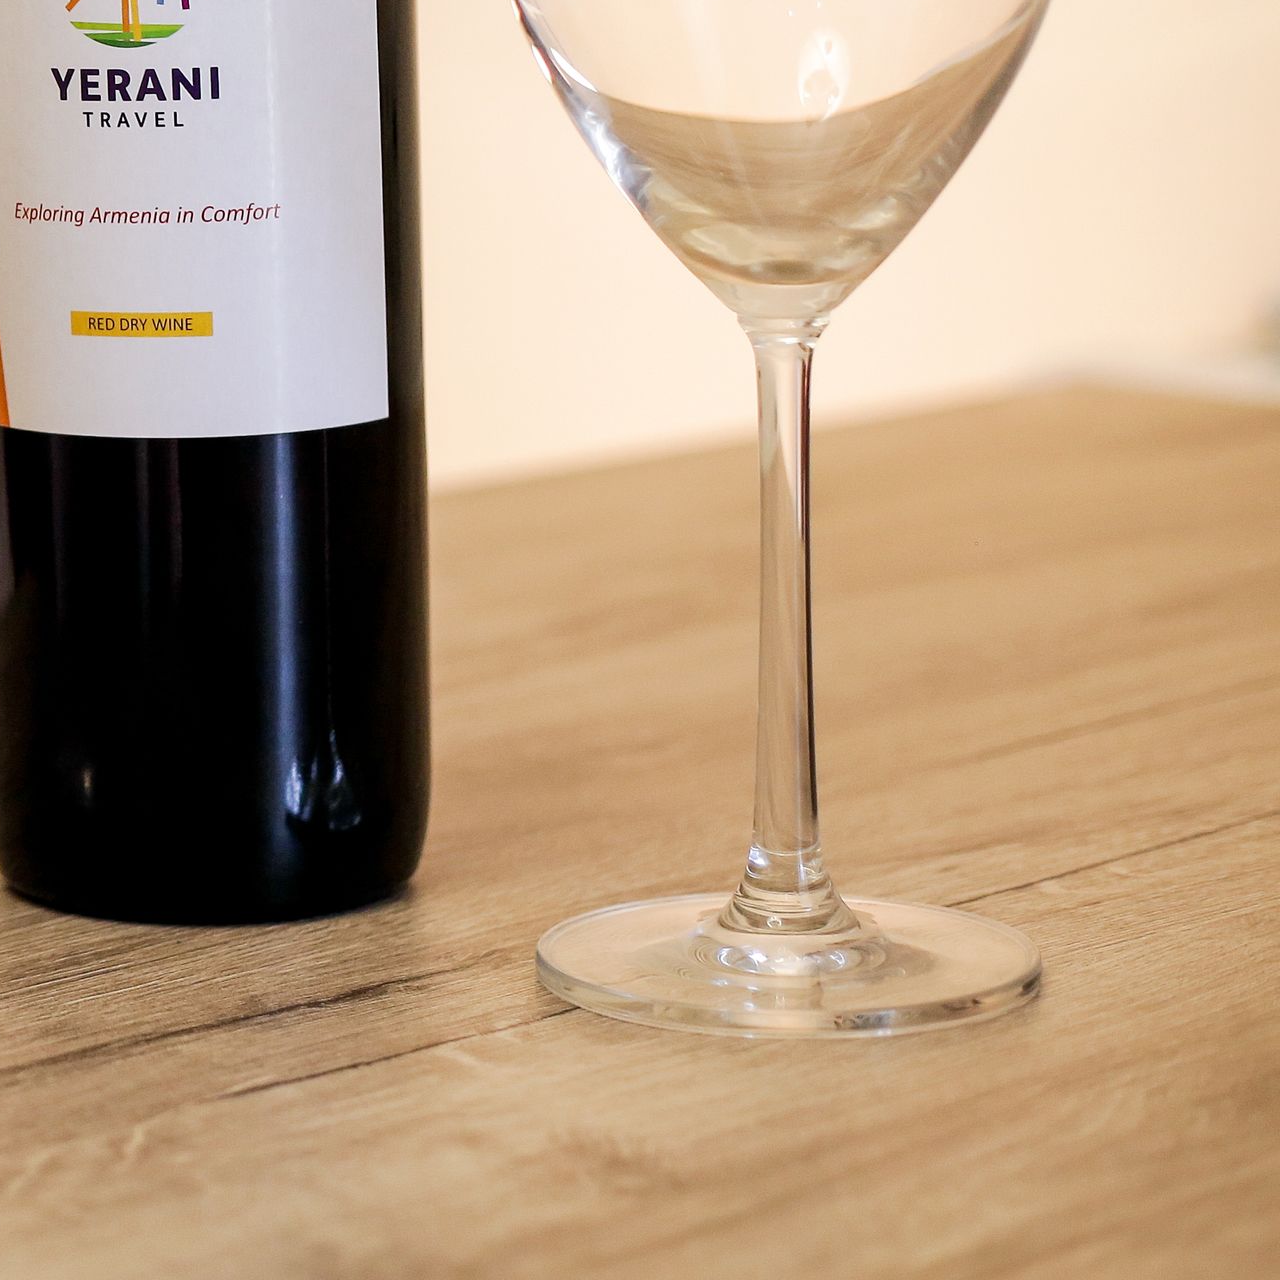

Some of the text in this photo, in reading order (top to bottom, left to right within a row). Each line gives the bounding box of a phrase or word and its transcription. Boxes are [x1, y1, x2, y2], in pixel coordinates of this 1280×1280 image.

[50, 66, 221, 102] YERANI
[82, 110, 185, 129] TRAVEL
[14, 201, 281, 228] Exploring Armenia in Comfort
[88, 316, 193, 332] RED DRY WINE
